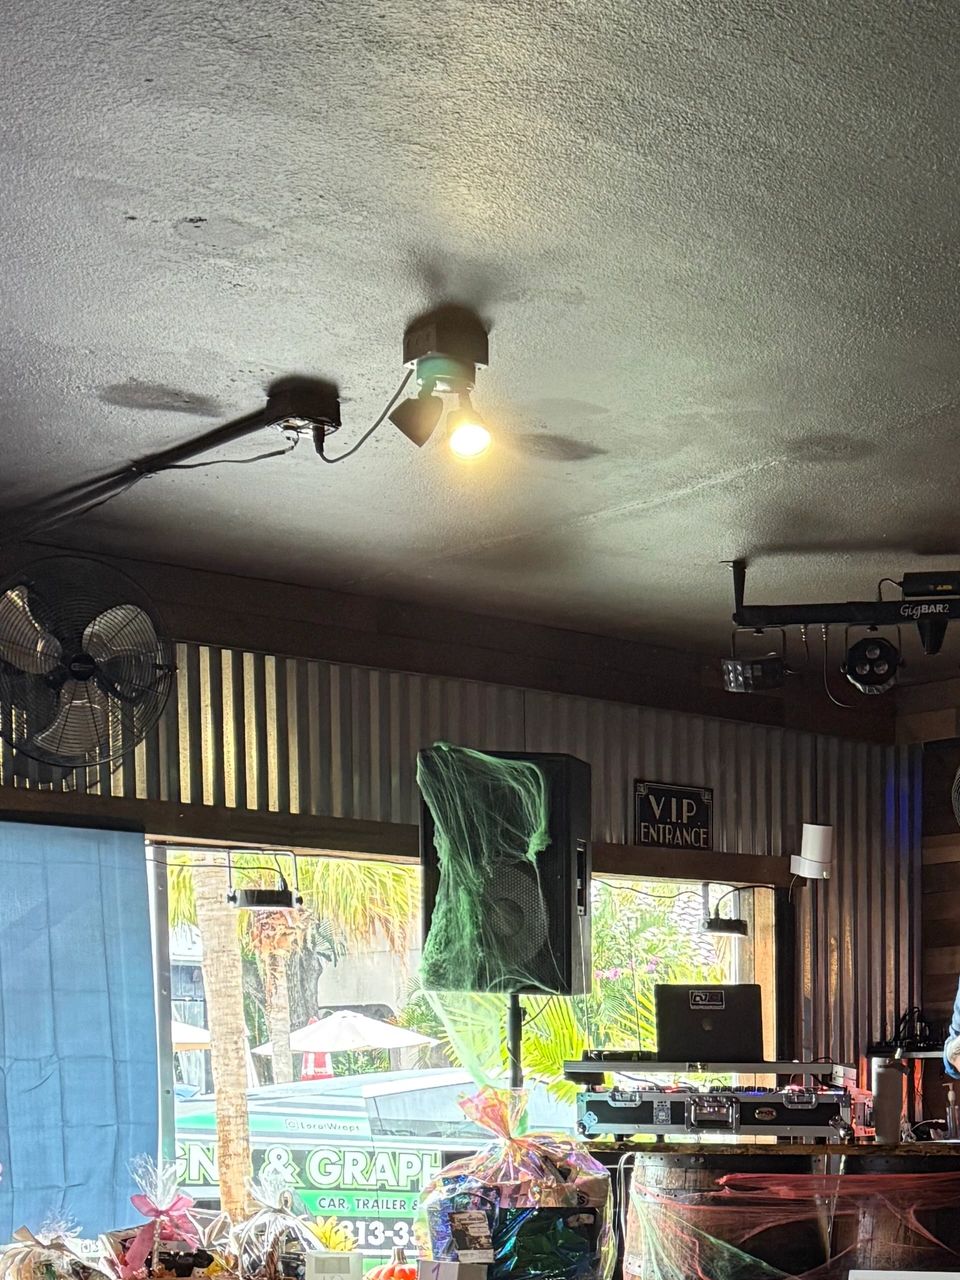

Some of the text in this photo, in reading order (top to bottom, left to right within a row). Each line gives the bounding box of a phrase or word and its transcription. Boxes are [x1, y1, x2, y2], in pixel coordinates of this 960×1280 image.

[900, 603, 950, 619] GigBAR2
[648, 794, 702, 825] V.I.P.
[640, 822, 709, 848] ENTRANCE
[318, 1197, 349, 1210] CAR,
[355, 1199, 405, 1211] TRAILER
